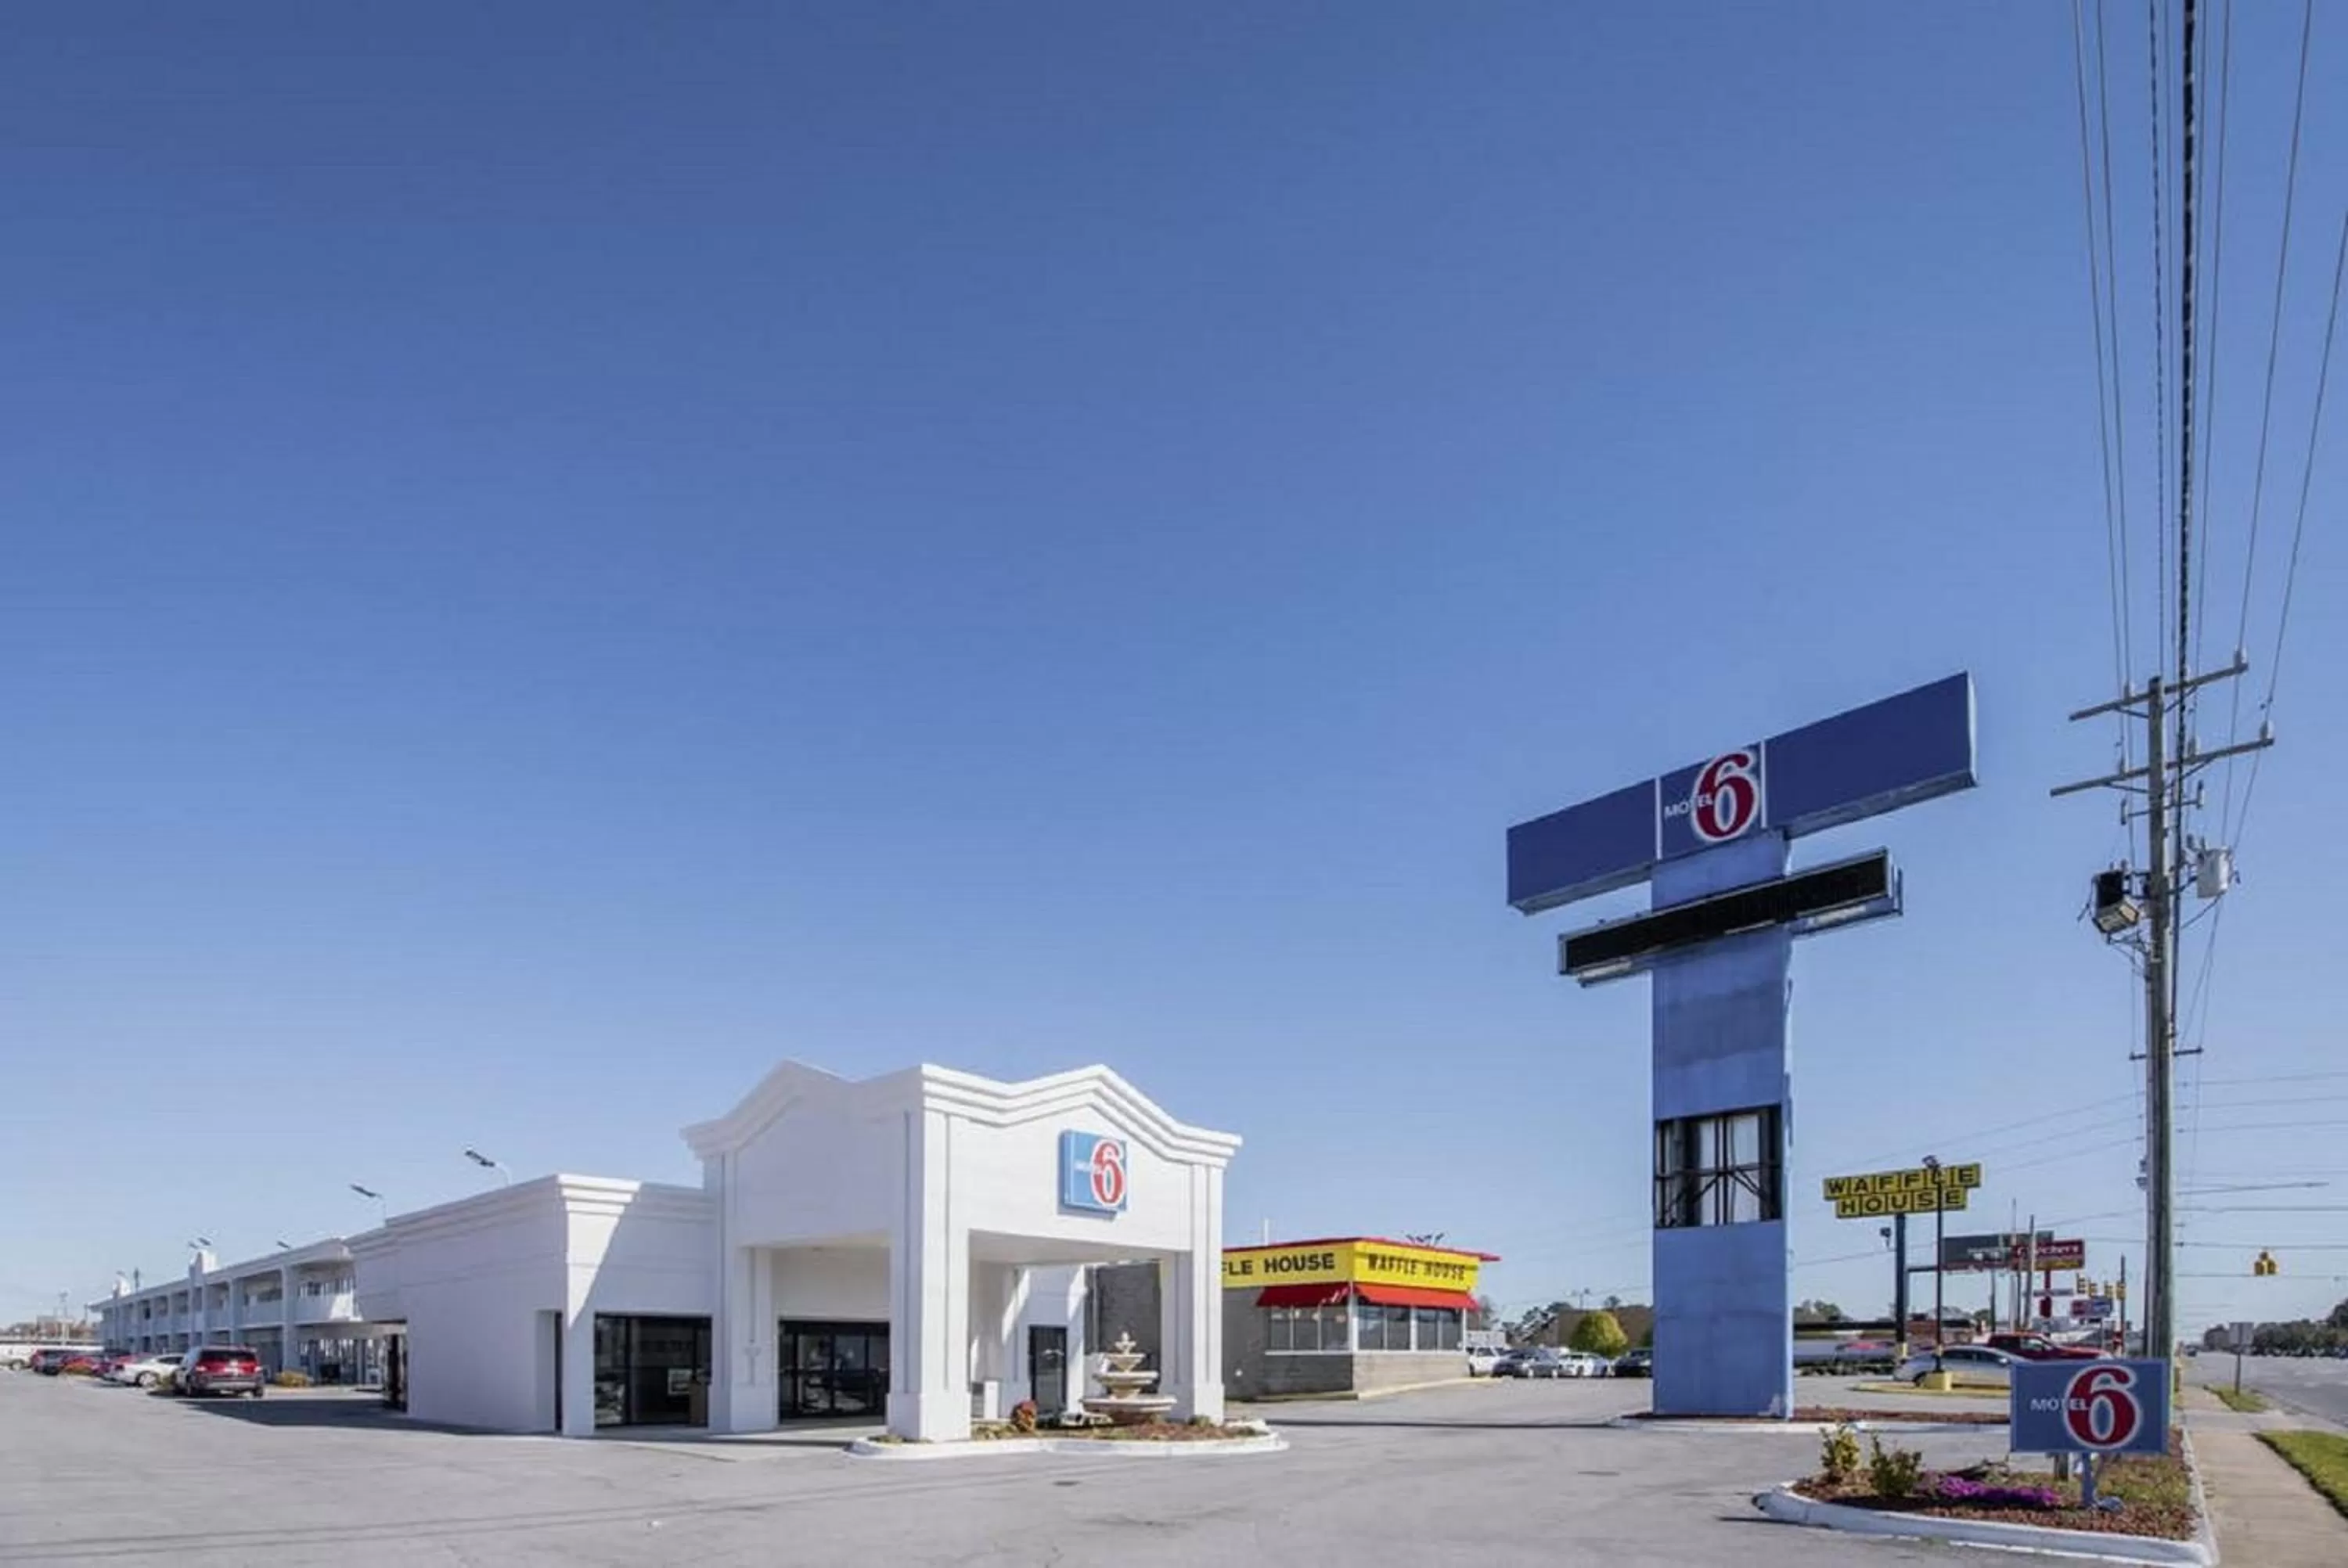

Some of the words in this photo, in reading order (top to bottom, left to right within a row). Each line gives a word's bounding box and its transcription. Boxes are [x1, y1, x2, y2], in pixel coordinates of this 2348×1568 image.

[1692, 750, 1758, 842] 6
[1090, 1139, 1126, 1207] 6
[1828, 1167, 1973, 1194] WAFFLE
[1841, 1189, 1960, 1214] HOUSE
[1264, 1253, 1335, 1273] HOUSE
[1369, 1253, 1417, 1275] WAFFLE
[2064, 1365, 2142, 1449] 6
